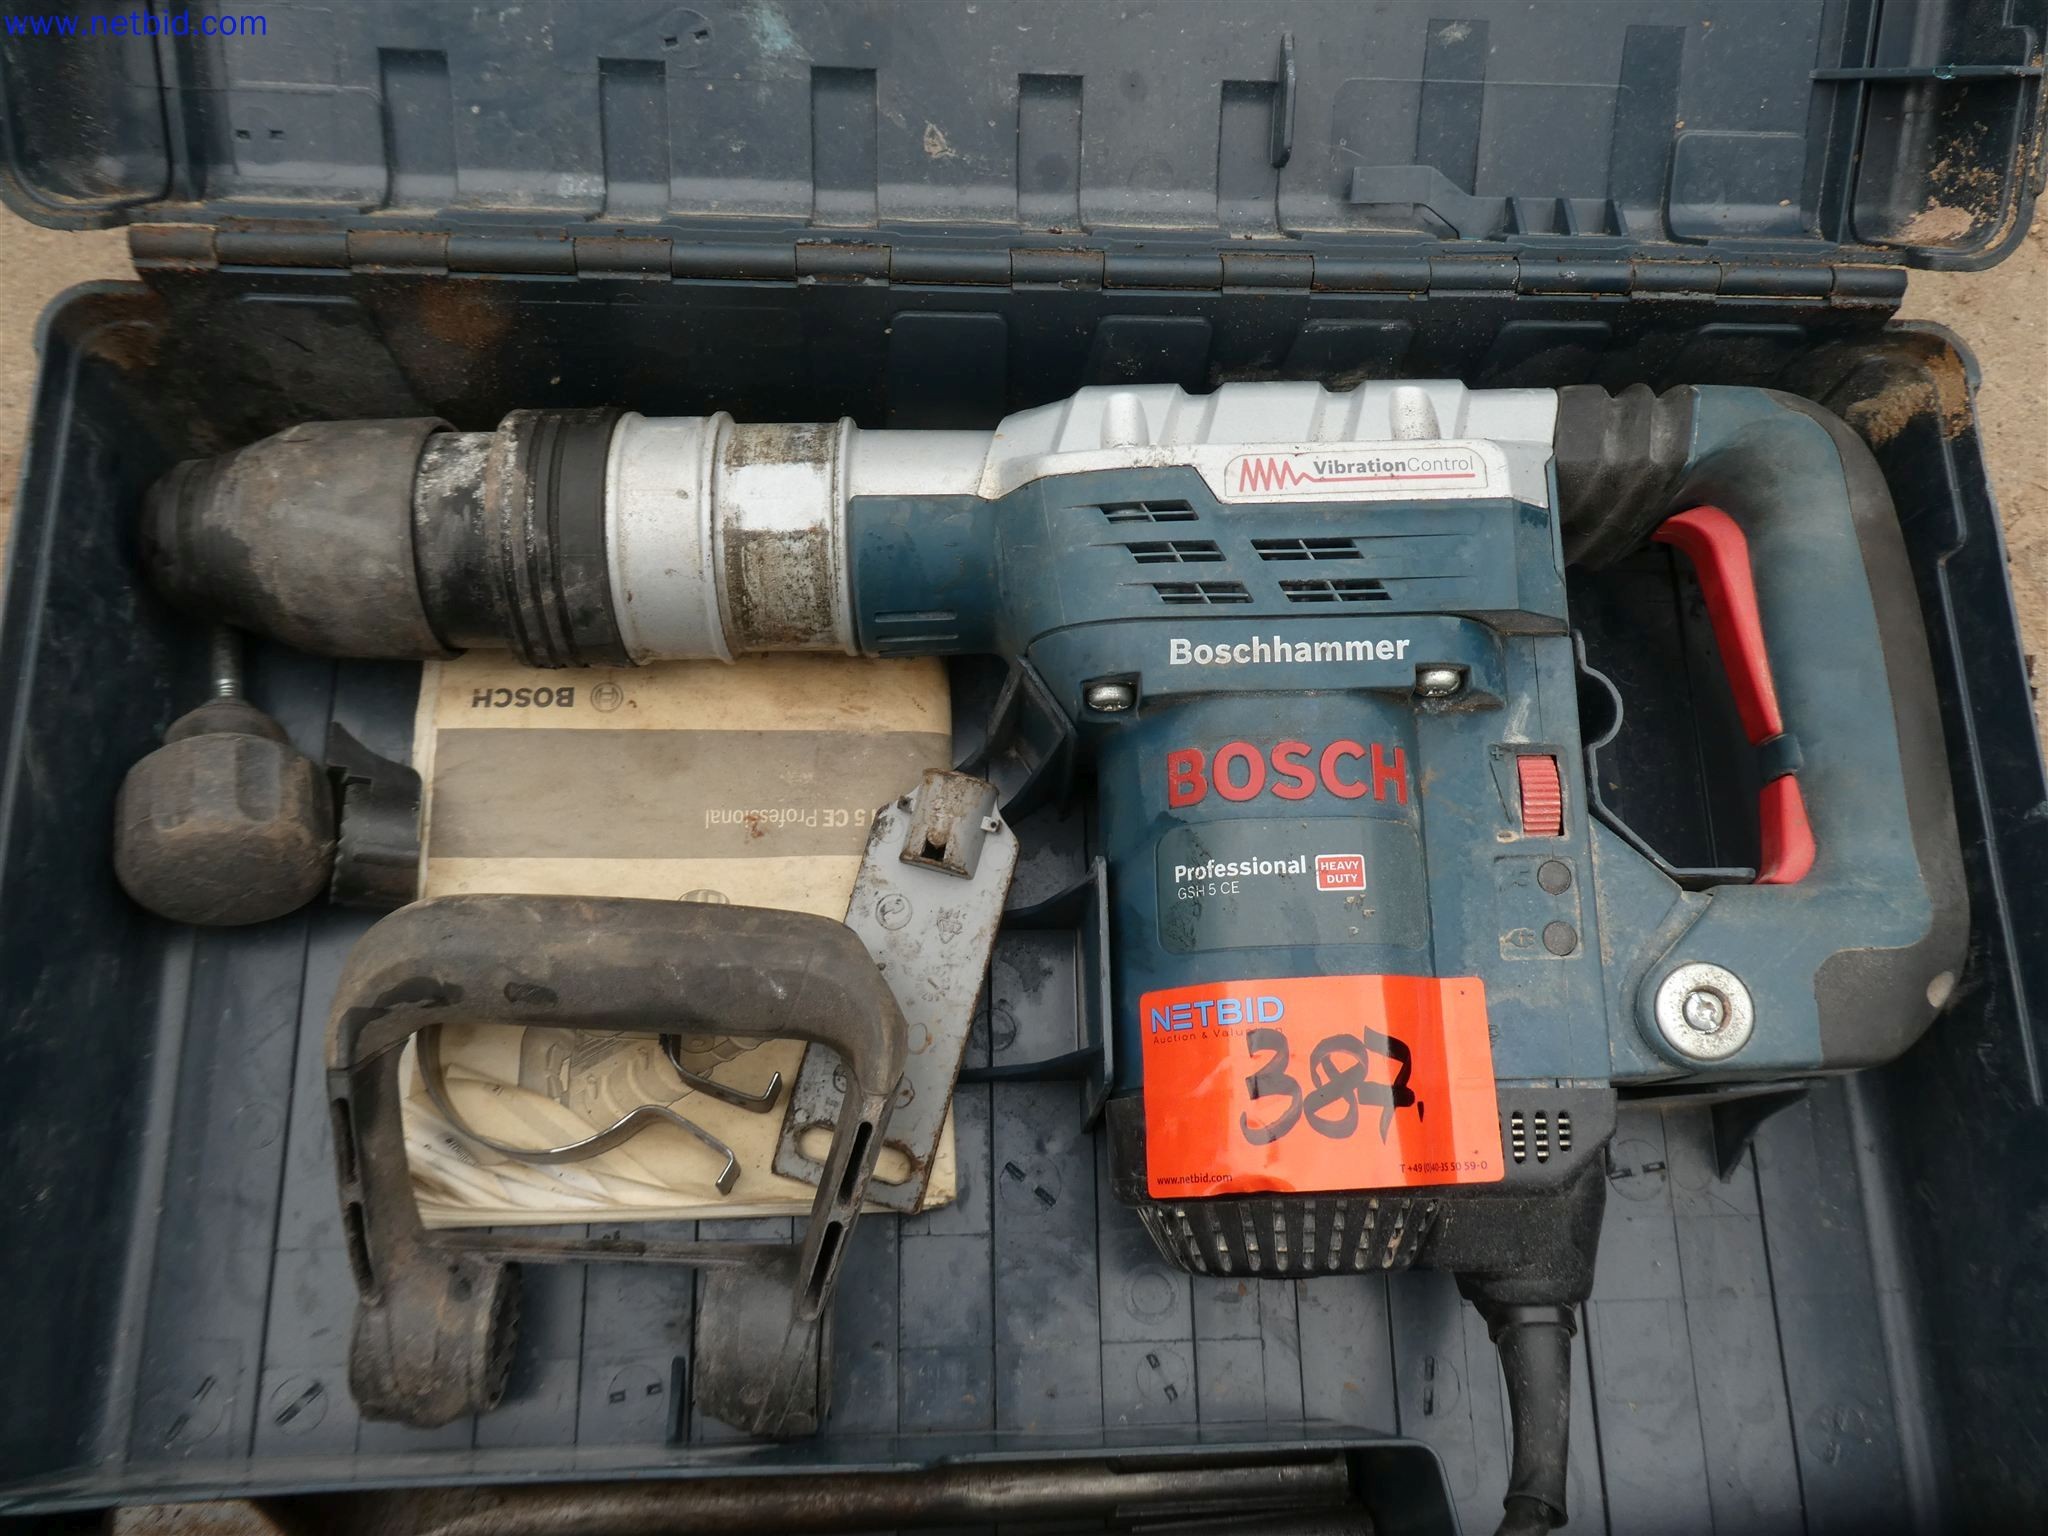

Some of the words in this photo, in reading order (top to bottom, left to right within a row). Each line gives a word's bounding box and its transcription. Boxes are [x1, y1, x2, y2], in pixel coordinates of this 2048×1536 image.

[1169, 635, 1410, 665] Boschhammer
[471, 686, 575, 708] BOSCH
[1167, 739, 1408, 809] BOSCH
[705, 808, 817, 829] Professional
[822, 808, 849, 827] CE
[854, 808, 866, 827] 5
[1175, 855, 1307, 883] Professional
[1320, 860, 1360, 871] HEAVY
[1326, 873, 1358, 884] DUTY
[1177, 884, 1205, 900] GSH
[1208, 882, 1217, 896] 5
[1220, 880, 1240, 895] CE
[1151, 996, 1285, 1034] NETBID
[1153, 1032, 1197, 1045] Auction
[1201, 1031, 1208, 1040] &
[1156, 1173, 1233, 1185] www.netbid.com
